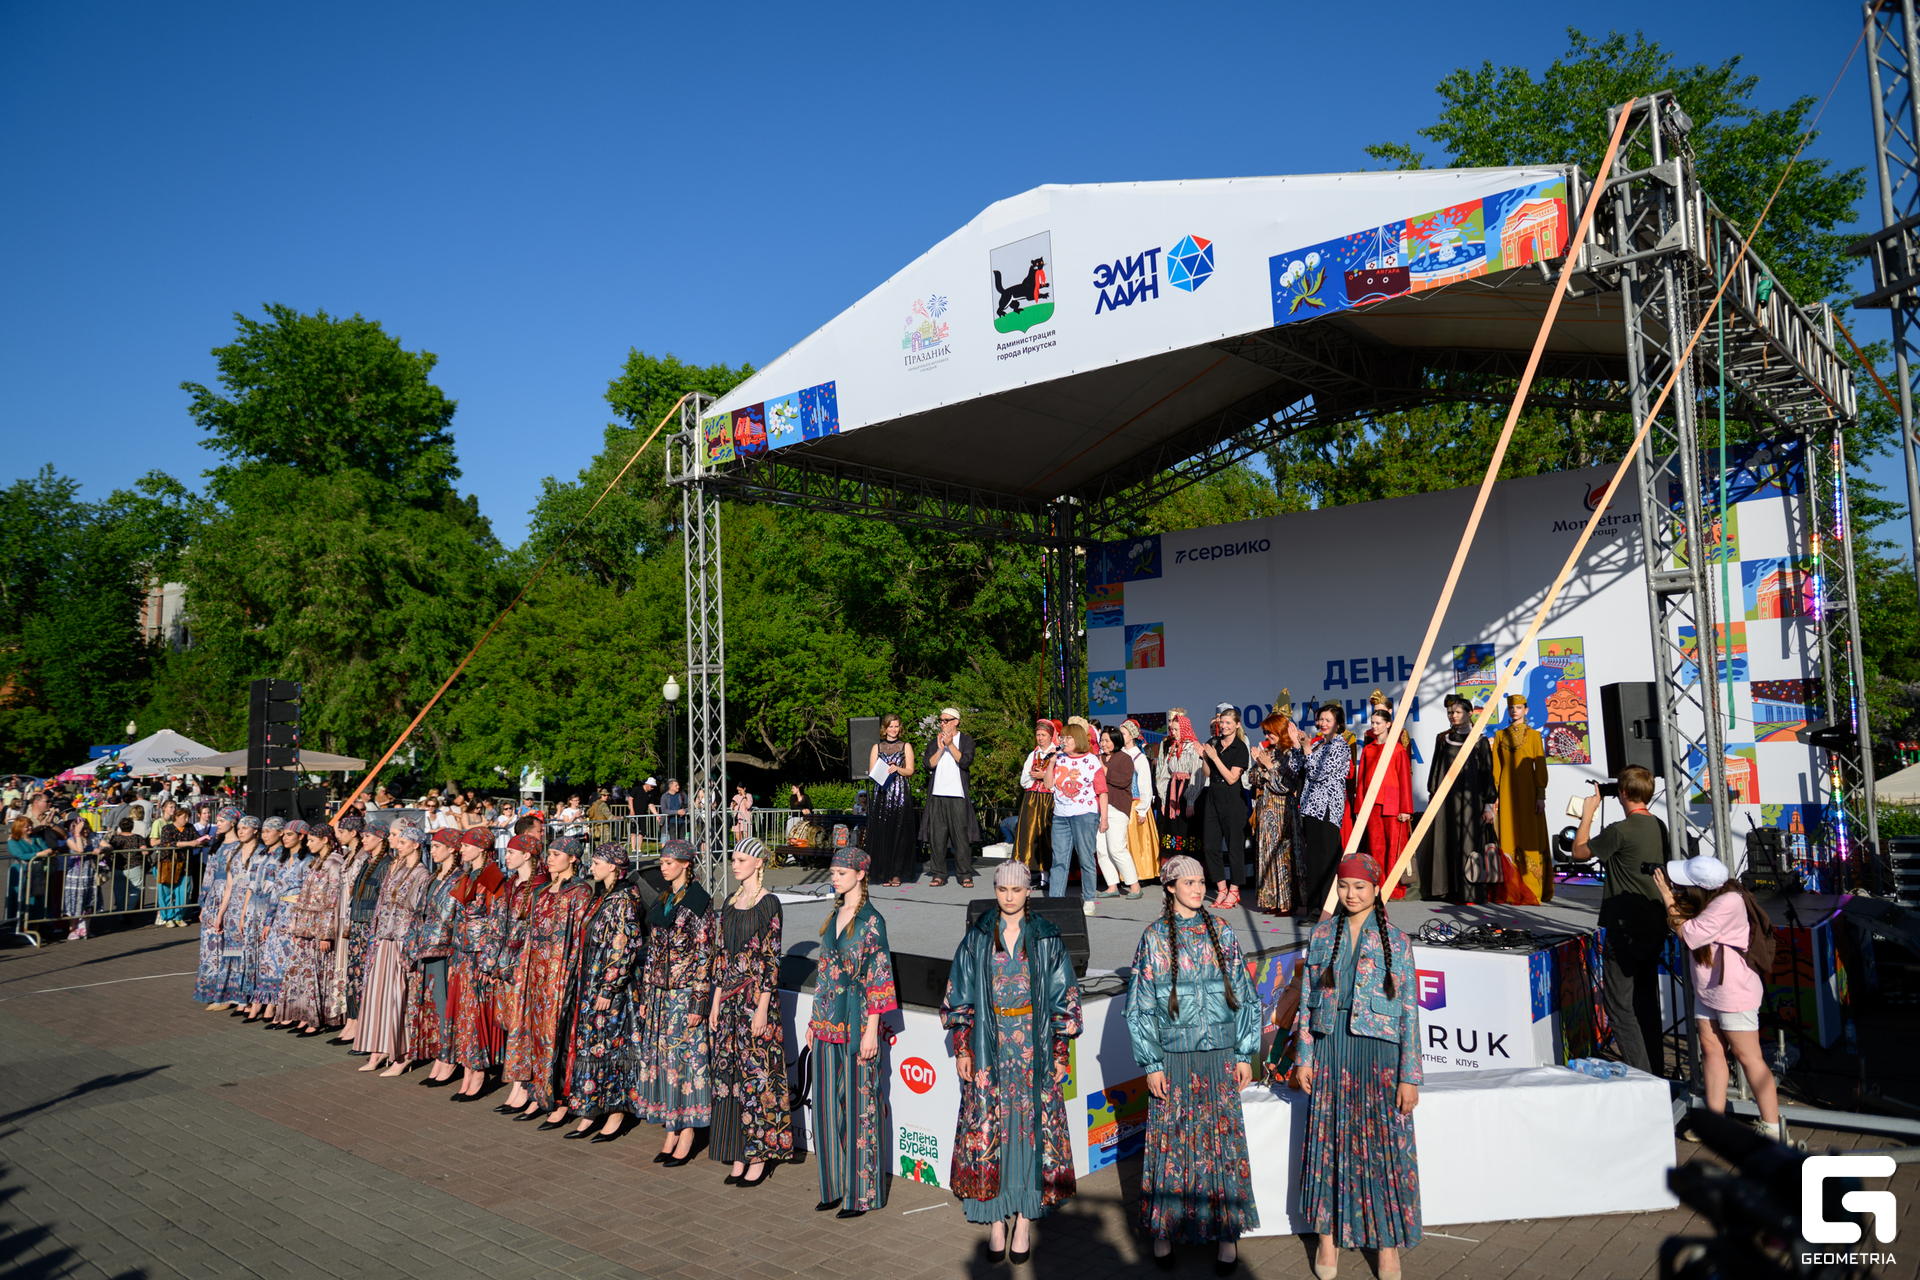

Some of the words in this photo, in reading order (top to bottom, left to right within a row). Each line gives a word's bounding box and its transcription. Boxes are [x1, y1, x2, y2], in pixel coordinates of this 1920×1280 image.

[1093, 246, 1162, 289] ЭЛИТ
[1095, 277, 1159, 315] ЛАЙН
[996, 329, 1056, 351] Администрация
[996, 349, 1022, 361] города
[1022, 340, 1057, 355] Иркутска
[1552, 512, 1642, 533] Monetran
[1589, 528, 1618, 540] roup
[1323, 655, 1415, 691] ДЕНЬ
[1419, 975, 1439, 1002] F
[1428, 1024, 1511, 1059] RUK
[1421, 1053, 1448, 1064] ИТНЕС
[1455, 1058, 1479, 1069] КЛУБ
[902, 1064, 934, 1086] ТОП
[899, 1126, 938, 1147] Зелёна
[899, 1139, 939, 1159] Бурёна
